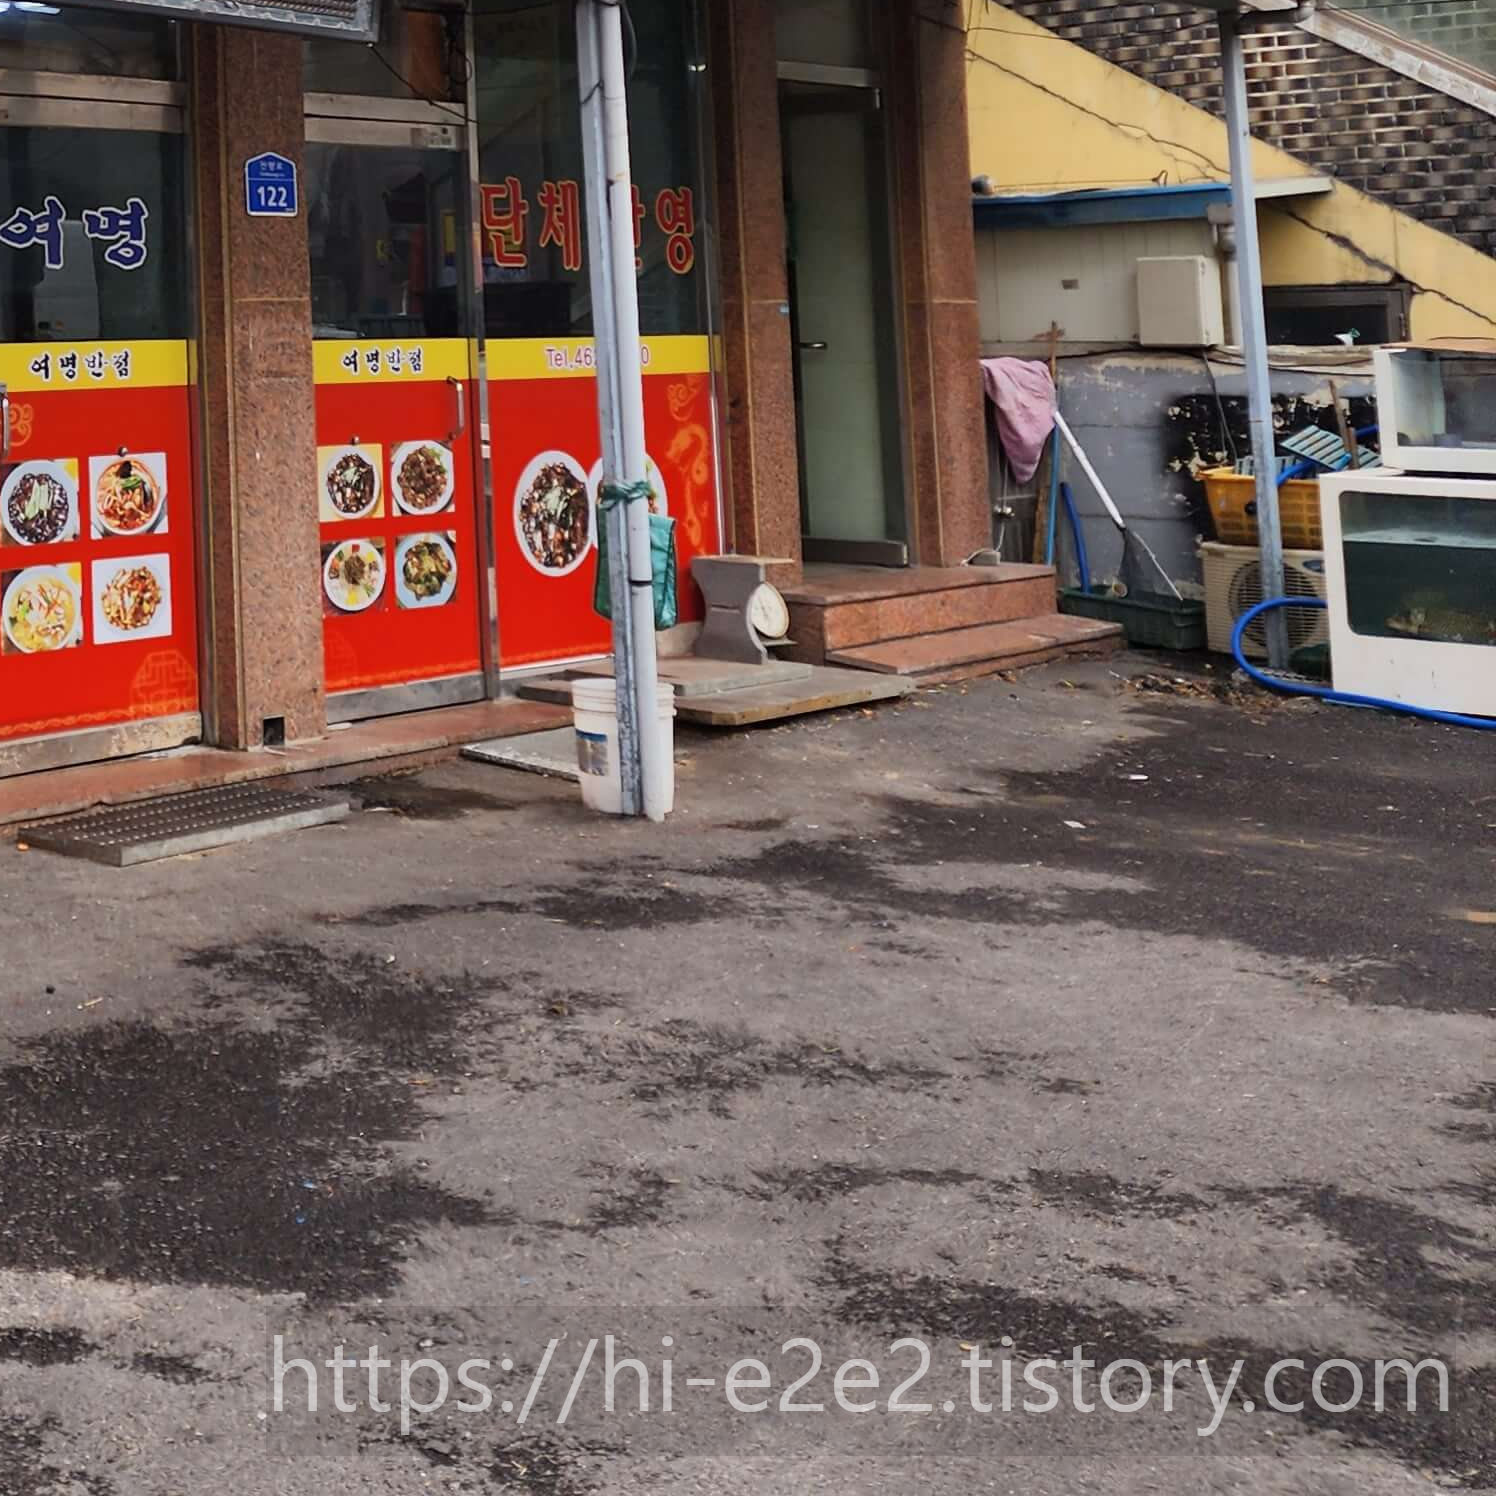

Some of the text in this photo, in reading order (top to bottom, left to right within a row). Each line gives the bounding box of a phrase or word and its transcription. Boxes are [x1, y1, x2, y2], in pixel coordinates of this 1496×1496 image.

[257, 185, 288, 208] 122
[30, 348, 132, 381] 여명반점
[341, 347, 425, 375] 여명반점
[545, 346, 650, 370] Tel.460
